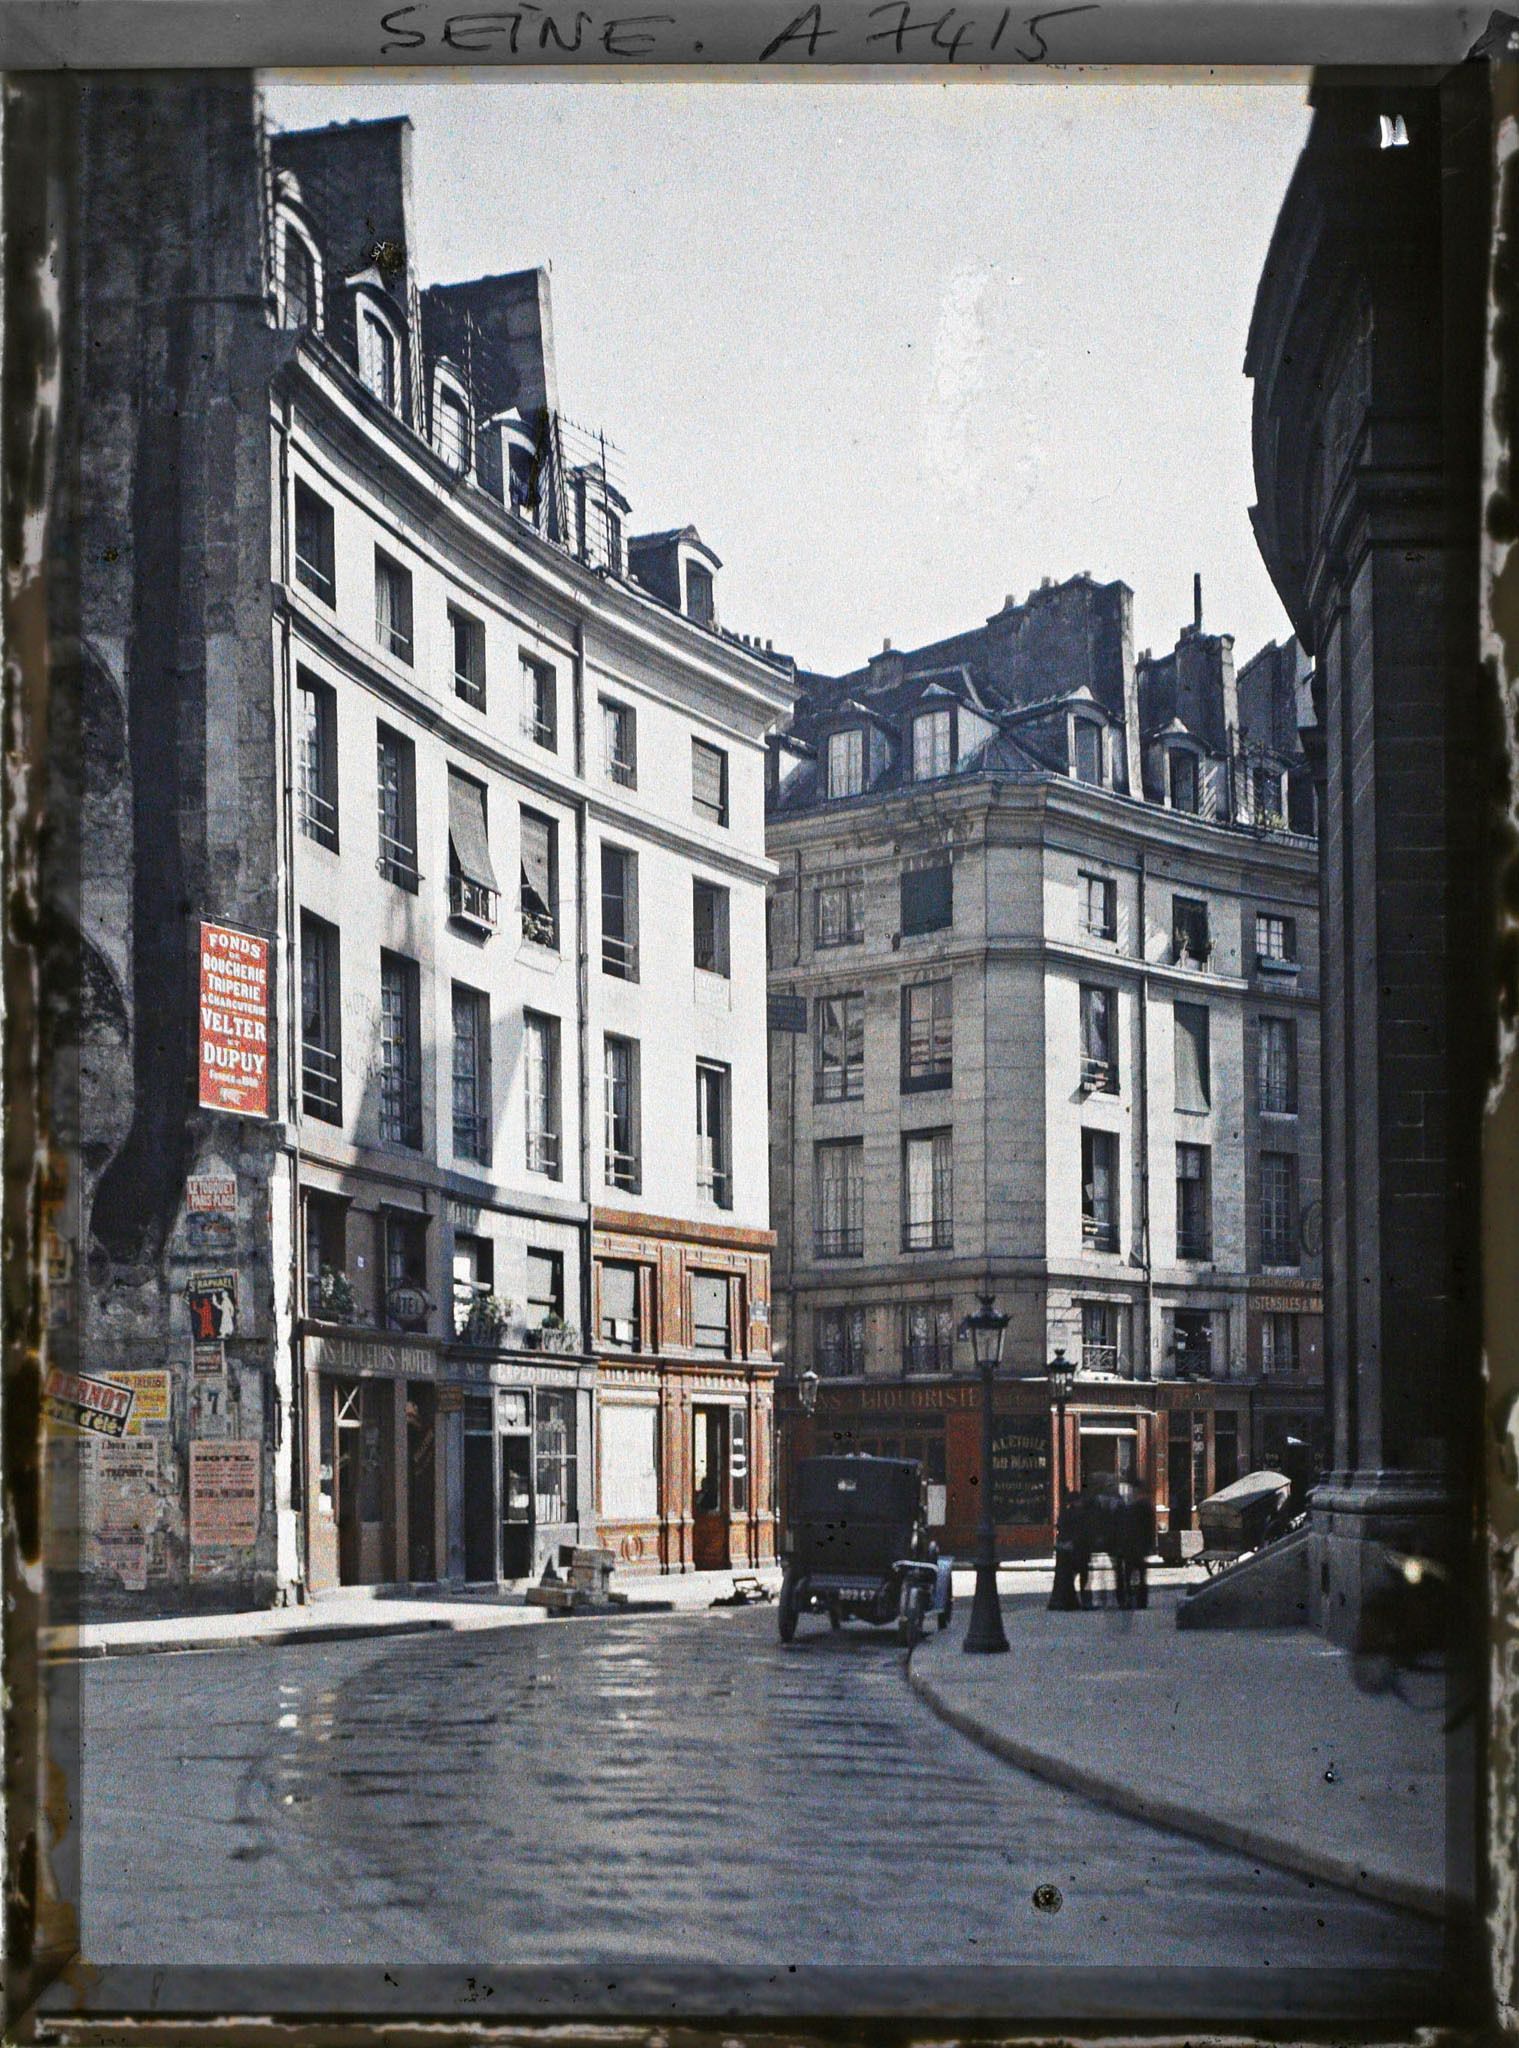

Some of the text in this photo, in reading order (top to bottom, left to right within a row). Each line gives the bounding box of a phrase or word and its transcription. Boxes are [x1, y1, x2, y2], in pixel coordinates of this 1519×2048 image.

[758, 3, 838, 62] A
[866, 1, 1102, 63] 7415
[208, 933, 260, 959] FONDS
[203, 952, 266, 985] BOUCHERIE
[208, 972, 261, 1001] TRIPERIE
[201, 1007, 266, 1042] VELTER
[203, 1041, 265, 1074] DUPUY
[341, 1341, 396, 1371] LIQUEURS
